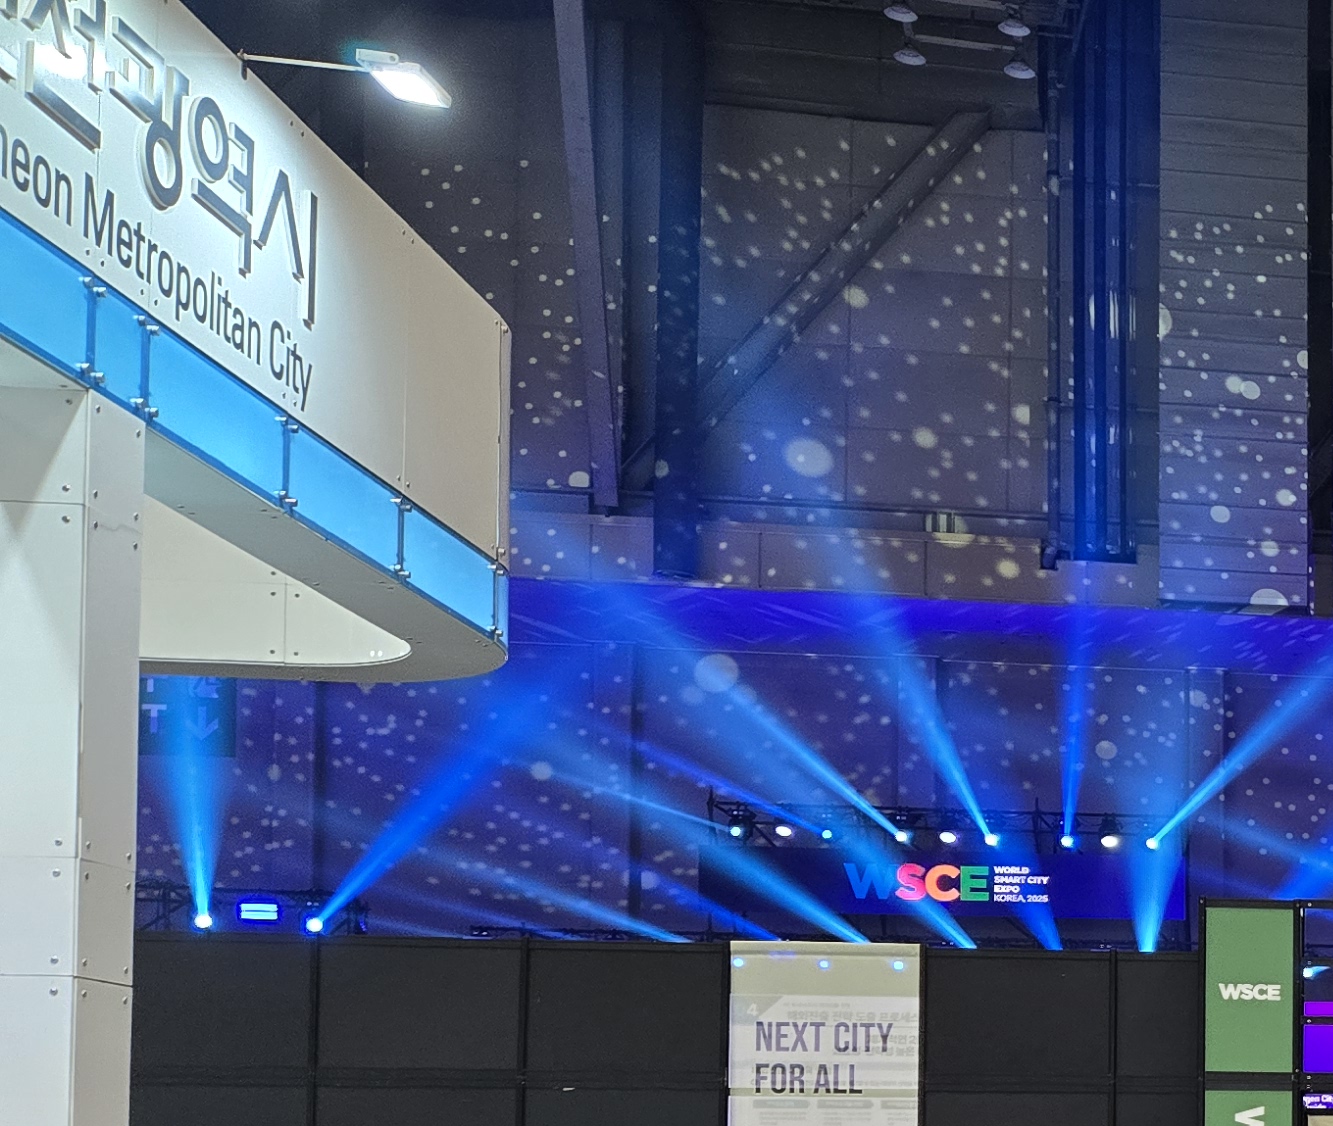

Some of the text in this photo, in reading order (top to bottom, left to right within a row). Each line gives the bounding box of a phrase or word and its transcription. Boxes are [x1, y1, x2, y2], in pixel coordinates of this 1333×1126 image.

[0, 0, 319, 330] 천광역시
[82, 170, 263, 366] Metropolitan
[269, 319, 314, 412] City
[993, 865, 1030, 874] WORLD
[993, 875, 1050, 884] SMART CITY
[844, 863, 989, 902] WSCE
[993, 884, 1020, 893] EXPO
[1026, 894, 1049, 903] 2025
[1219, 983, 1281, 1001] WSCE
[755, 1021, 894, 1053] NEXT CITY
[755, 1063, 863, 1094] FOR ALL
